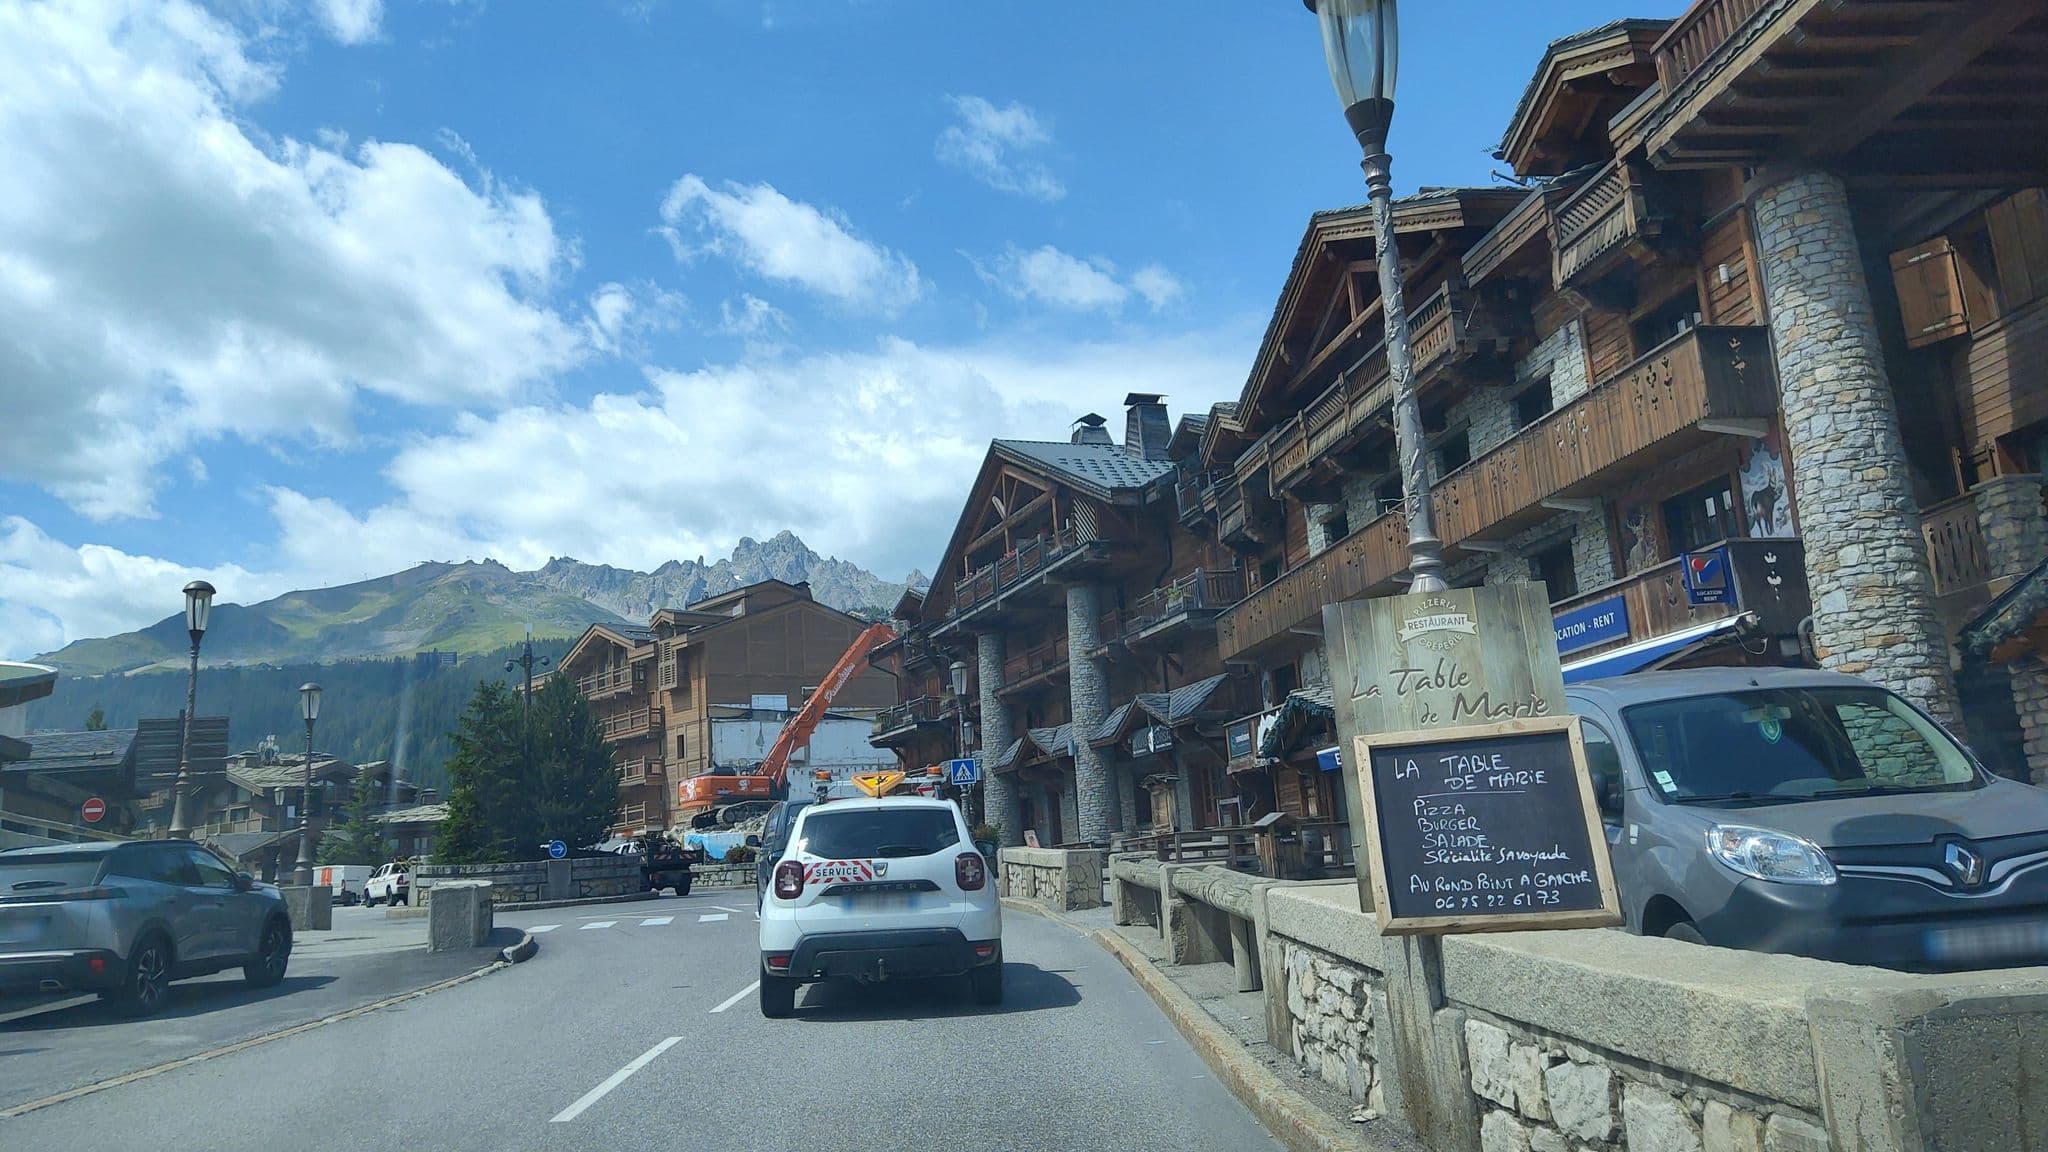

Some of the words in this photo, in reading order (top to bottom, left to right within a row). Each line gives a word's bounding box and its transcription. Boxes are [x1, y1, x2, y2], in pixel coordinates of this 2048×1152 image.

[1413, 598, 1457, 616] PIZZERIA
[1407, 616, 1466, 631] RESTAURANT
[1592, 612, 1615, 629] RENT
[1350, 676, 1382, 701] La
[1389, 657, 1473, 697] Table
[1420, 702, 1440, 724] de
[1394, 757, 1420, 780] LA
[1440, 754, 1510, 777] TABLE
[1444, 774, 1477, 790] DE
[1418, 816, 1480, 832] BURGER
[815, 867, 859, 878] SERVICE
[842, 883, 918, 893] DUSTER
[1410, 874, 1430, 894] AU
[1520, 878, 1530, 886] A
[1534, 870, 1592, 888] GAUCHE
[1435, 896, 1455, 909] 06
[1513, 893, 1531, 906] 61
[1537, 890, 1560, 905] 73
